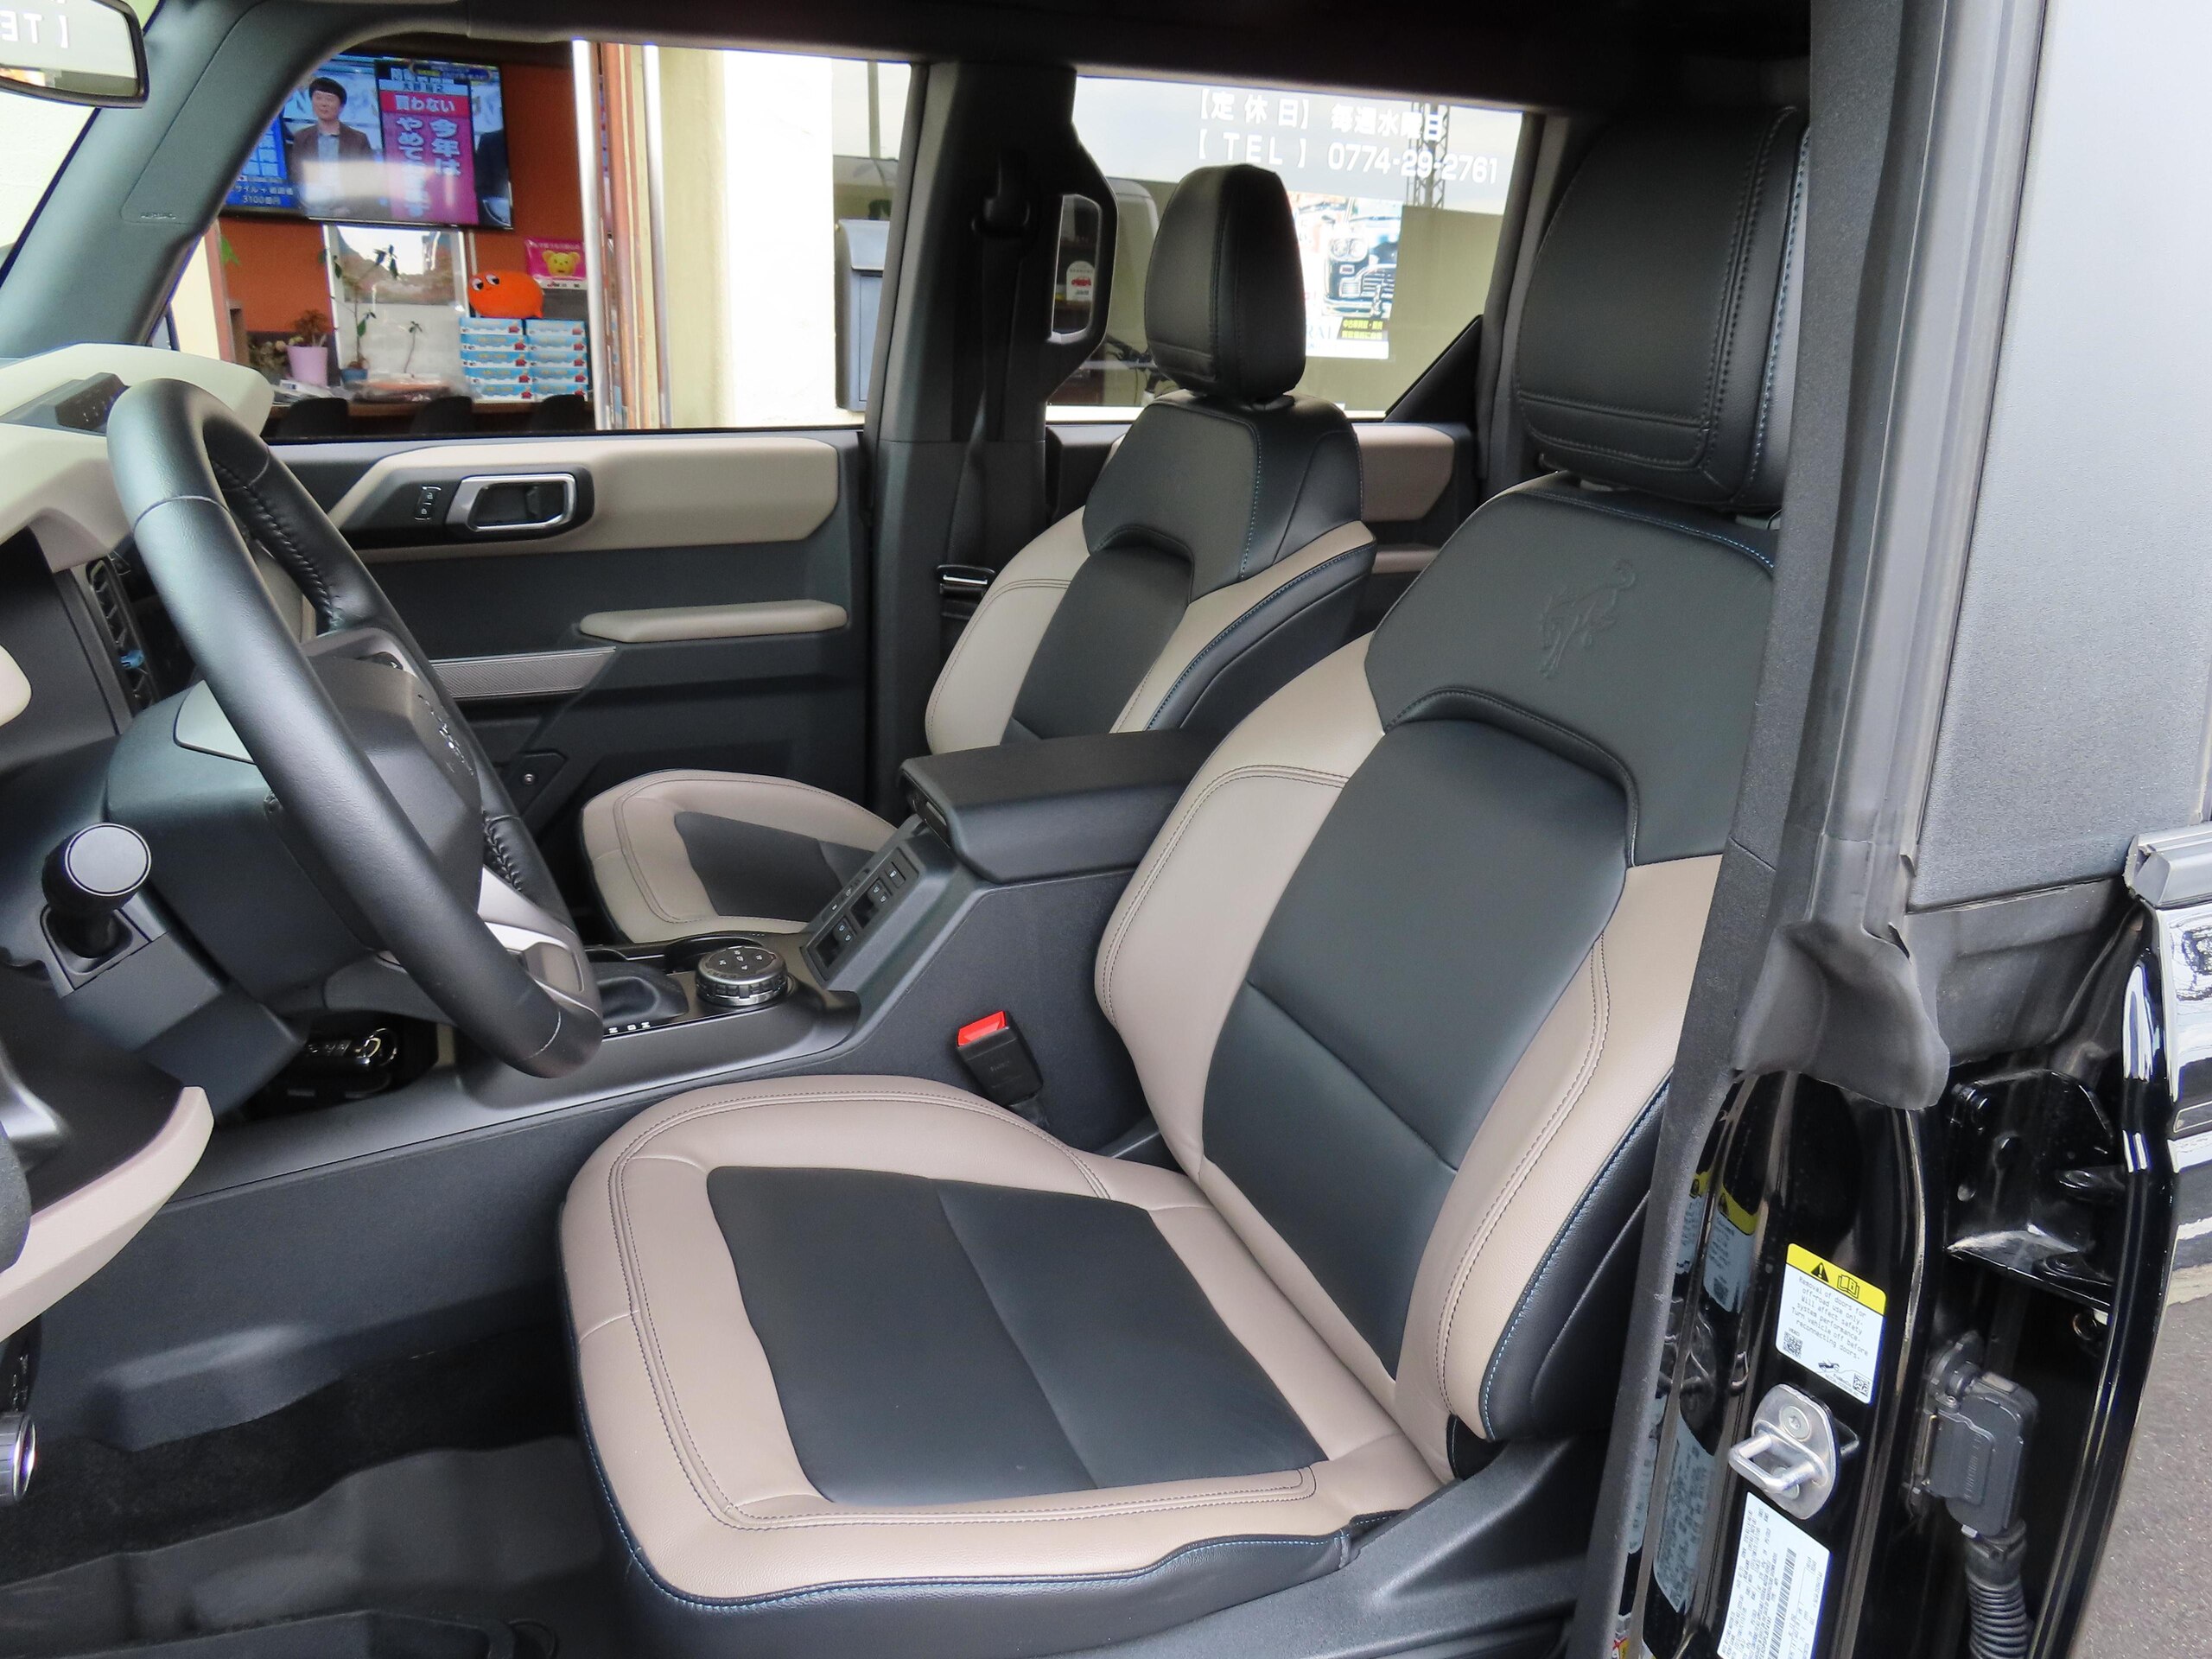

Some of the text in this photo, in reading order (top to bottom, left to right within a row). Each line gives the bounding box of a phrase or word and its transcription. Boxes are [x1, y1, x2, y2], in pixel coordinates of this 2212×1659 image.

[1327, 142, 1498, 185] 0774-29-2761
[1796, 1302, 1817, 1319] system
[1801, 1294, 1862, 1335] Will affect safety
[1802, 1287, 1830, 1307] off-road
[1832, 1304, 1843, 1315] use
[1834, 1294, 1853, 1312] doors
[1854, 1307, 1866, 1318] for
[1791, 1306, 1868, 1356] Turn vehicle off before
[1796, 1319, 1837, 1348] reconnecting
